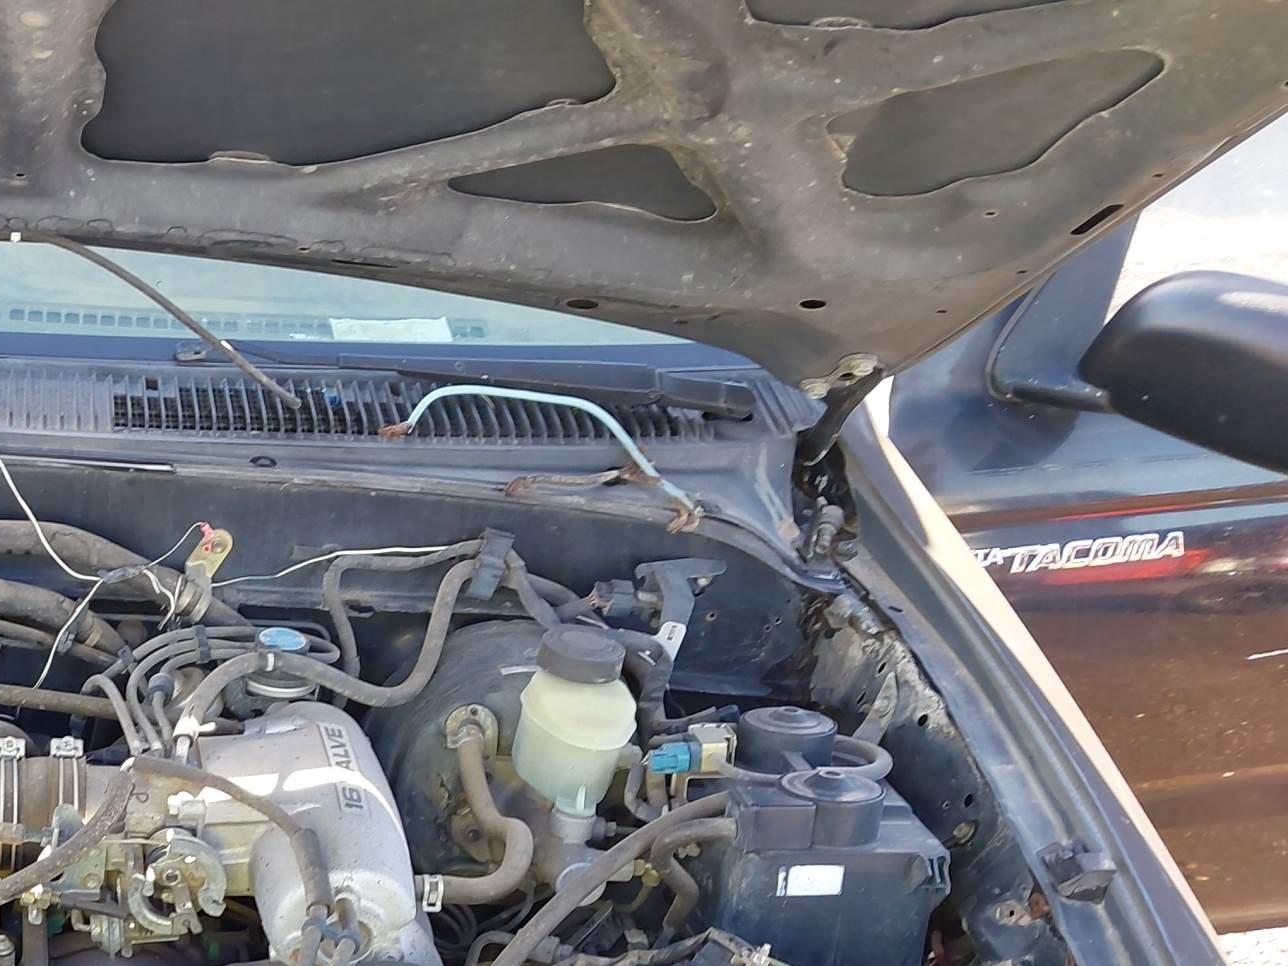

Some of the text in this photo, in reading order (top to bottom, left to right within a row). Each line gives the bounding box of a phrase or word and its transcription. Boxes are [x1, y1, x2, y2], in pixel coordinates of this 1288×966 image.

[1006, 531, 1184, 574] TACOMA
[324, 725, 365, 809] 16 ALVE
